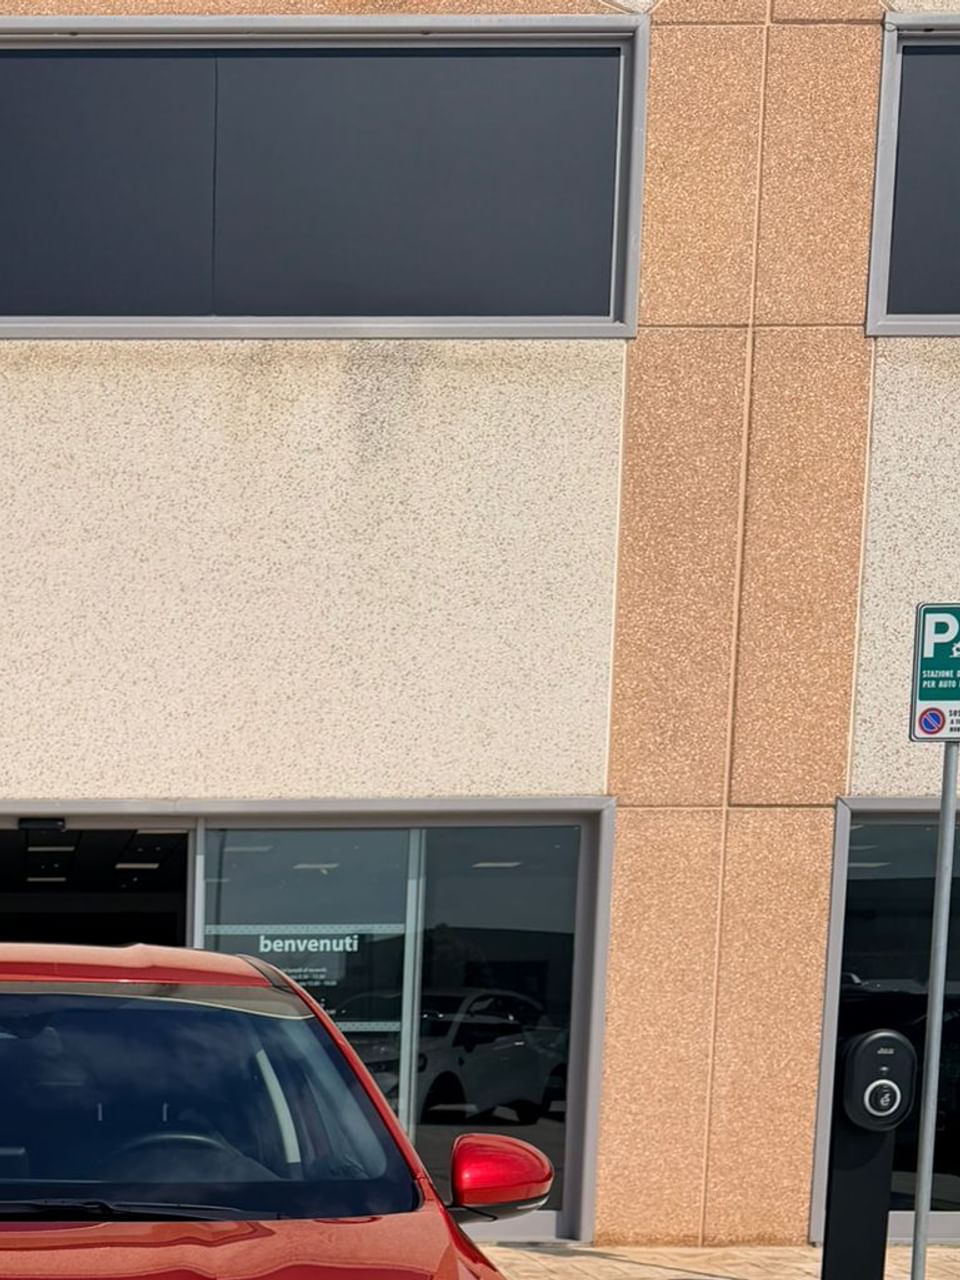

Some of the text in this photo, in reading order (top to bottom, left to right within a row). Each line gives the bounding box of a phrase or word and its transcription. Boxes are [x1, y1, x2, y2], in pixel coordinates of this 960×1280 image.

[923, 613, 959, 658] P
[922, 670, 954, 678] STAZIONE
[922, 680, 936, 688] PER
[938, 680, 957, 688] AUTO
[259, 935, 358, 952] benvenuti
